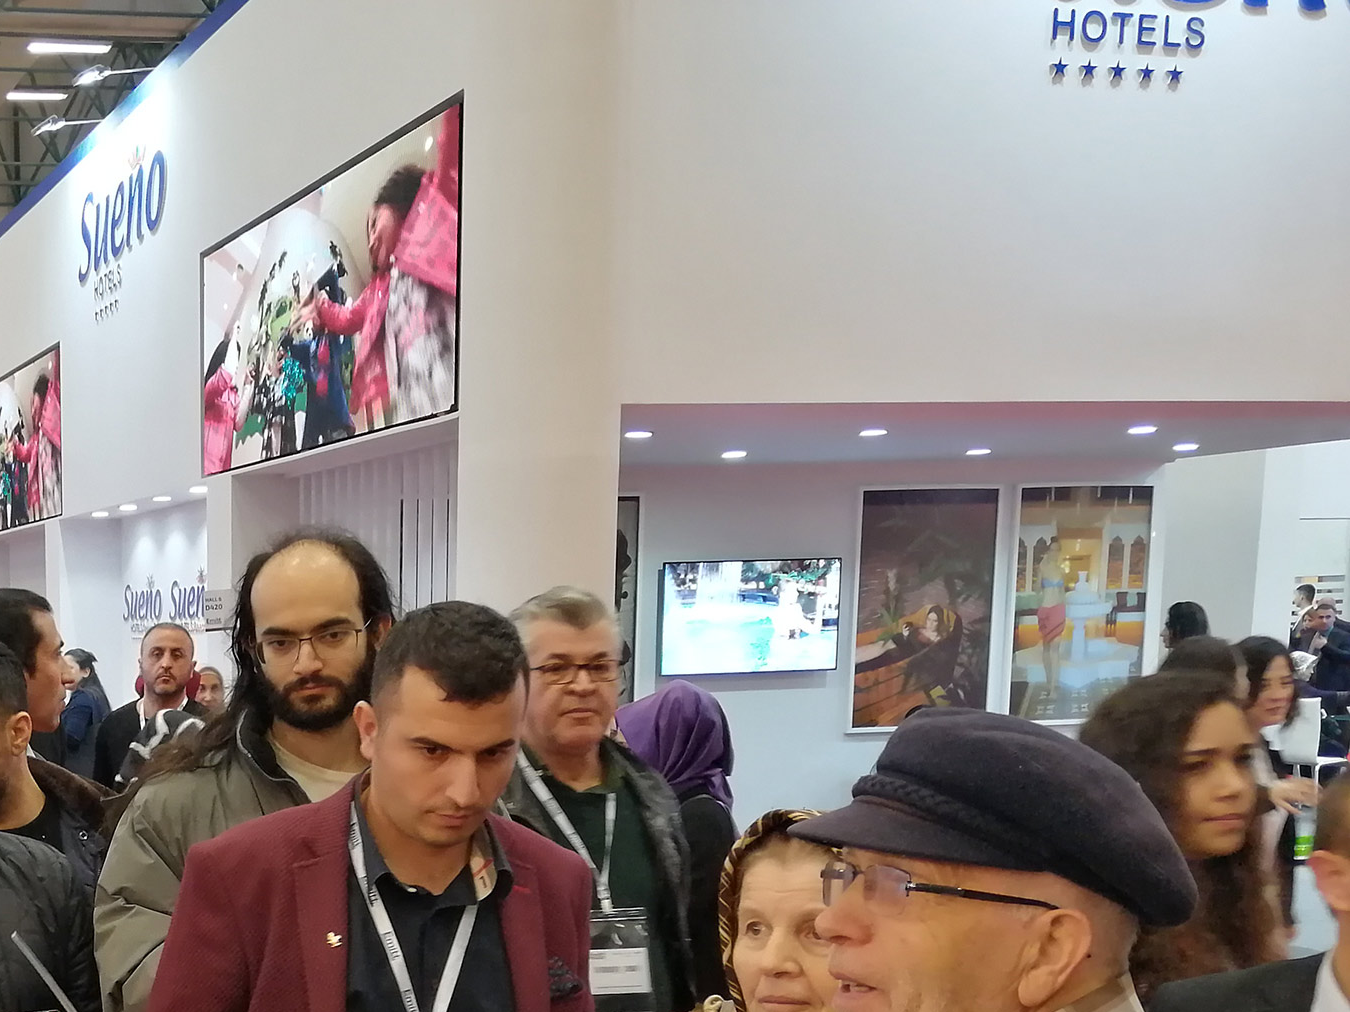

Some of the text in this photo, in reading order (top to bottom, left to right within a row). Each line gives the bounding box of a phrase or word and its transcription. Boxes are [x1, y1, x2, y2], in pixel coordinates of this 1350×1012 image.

[1052, 8, 1206, 50] HOTELS
[94, 263, 122, 301] HOTELS
[169, 580, 206, 621] Suen
